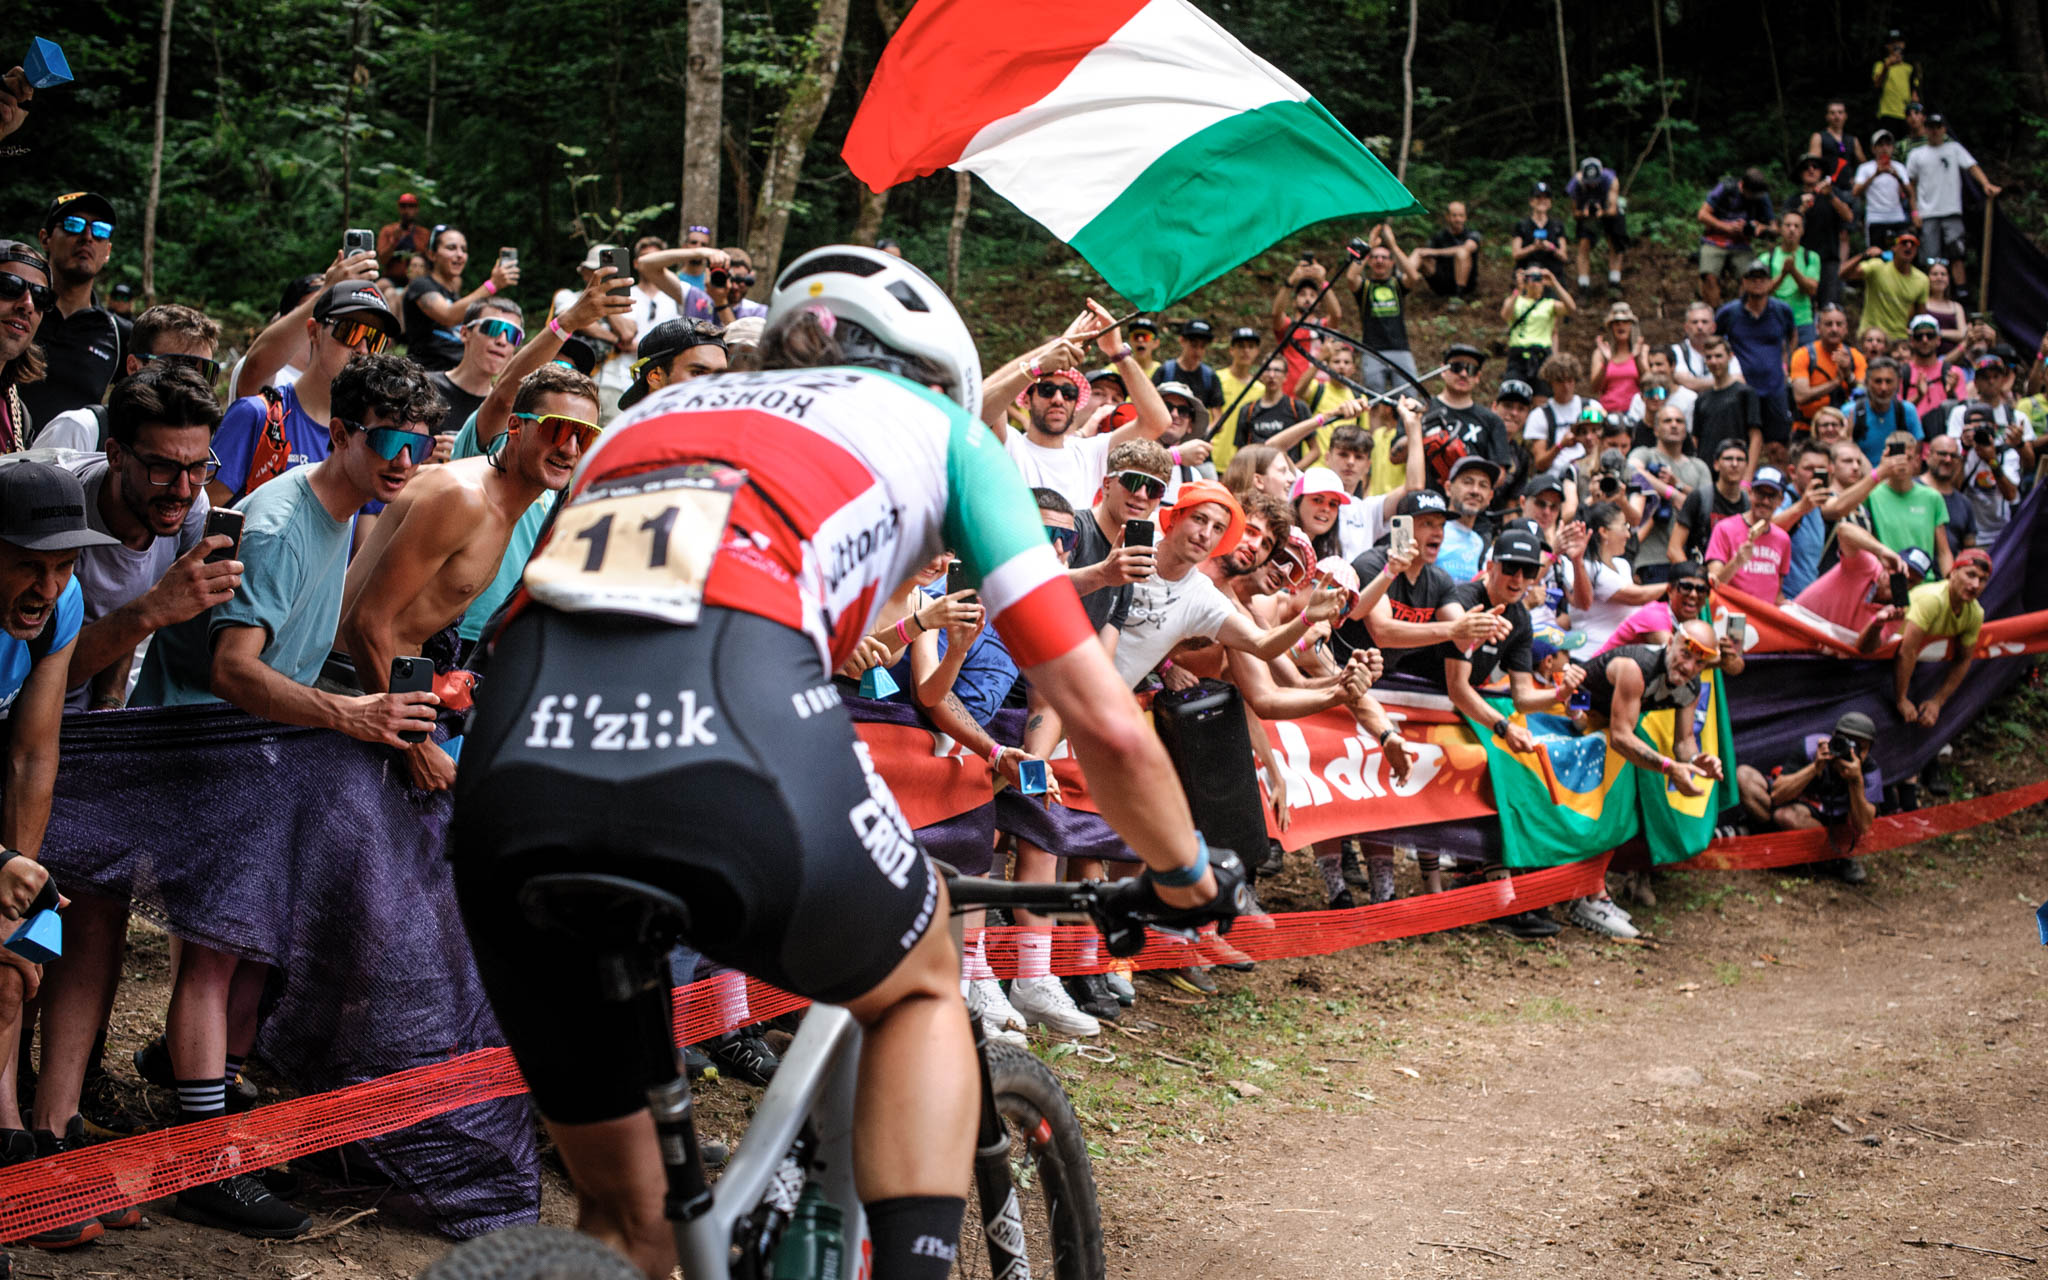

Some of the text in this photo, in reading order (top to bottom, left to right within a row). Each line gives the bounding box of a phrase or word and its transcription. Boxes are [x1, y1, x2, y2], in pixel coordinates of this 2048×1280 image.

[575, 504, 681, 573] 11
[525, 689, 719, 752] fi'zi:k
[849, 797, 919, 891] CRUZ
